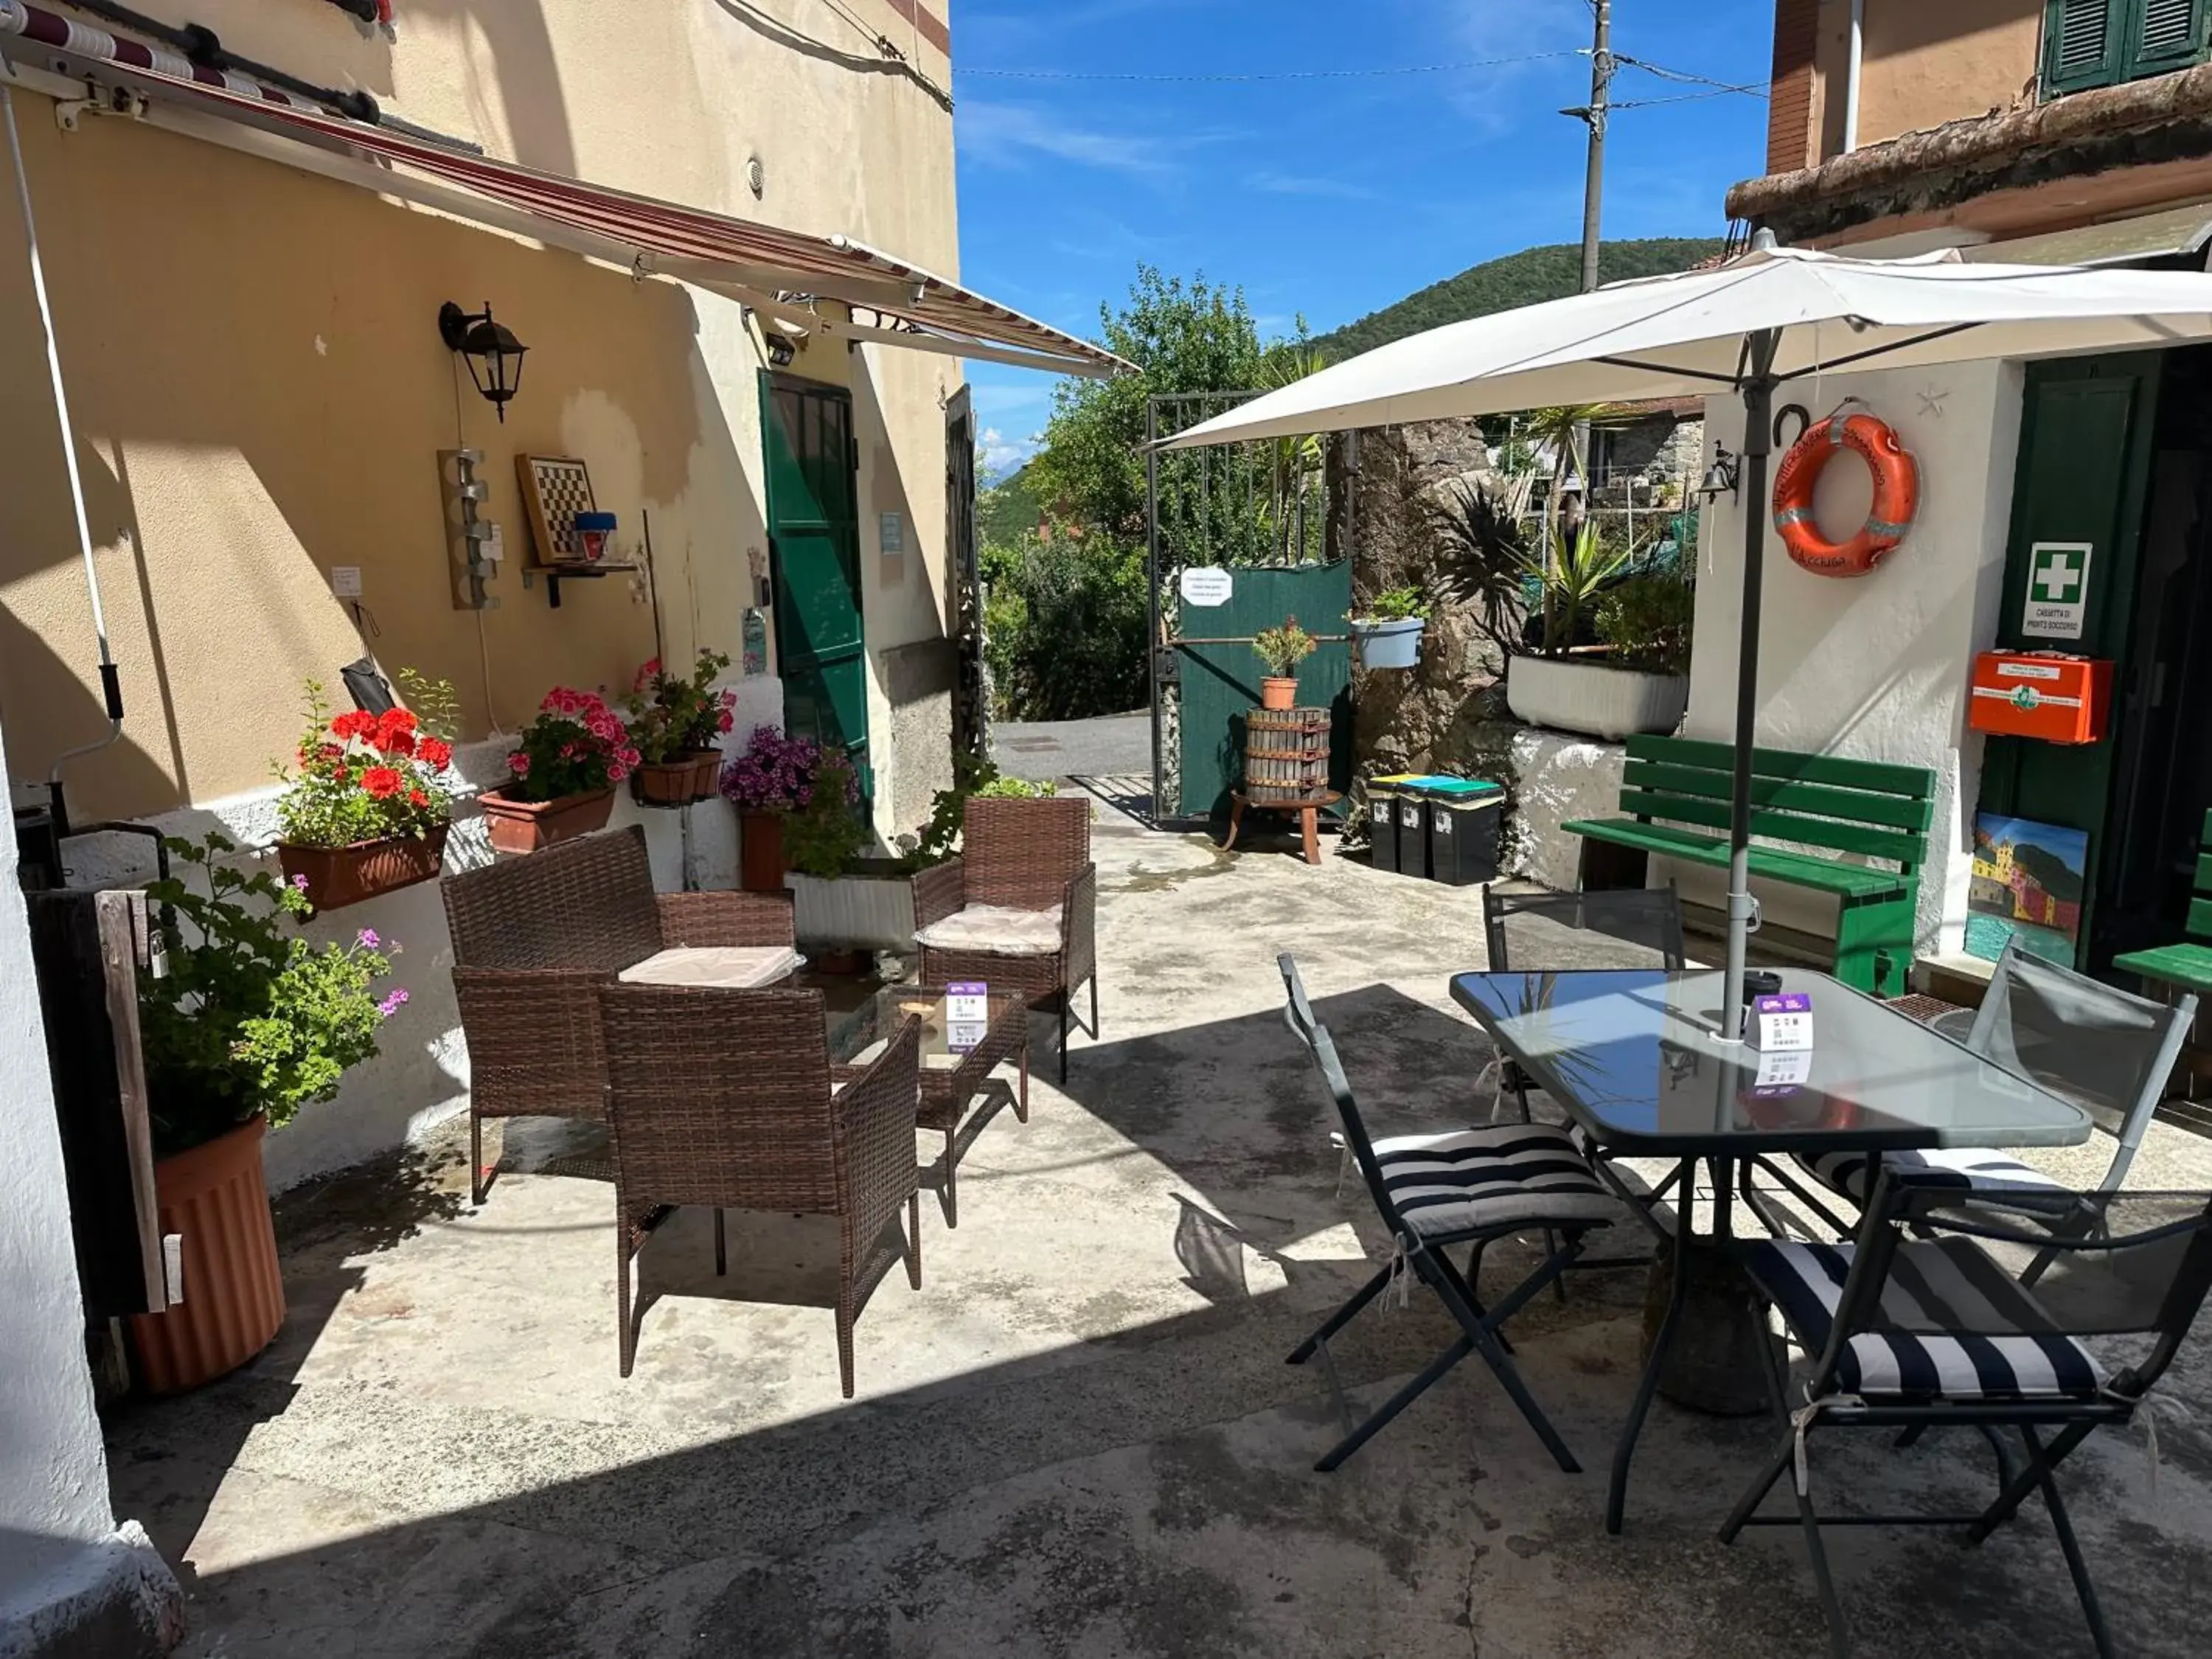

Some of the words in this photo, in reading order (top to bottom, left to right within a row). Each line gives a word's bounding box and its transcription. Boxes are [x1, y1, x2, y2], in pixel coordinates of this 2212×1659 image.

[2036, 608, 2064, 617] CASSETTA
[2028, 620, 2048, 629] PRONTO
[2048, 621, 2078, 630] SOCCORSO
